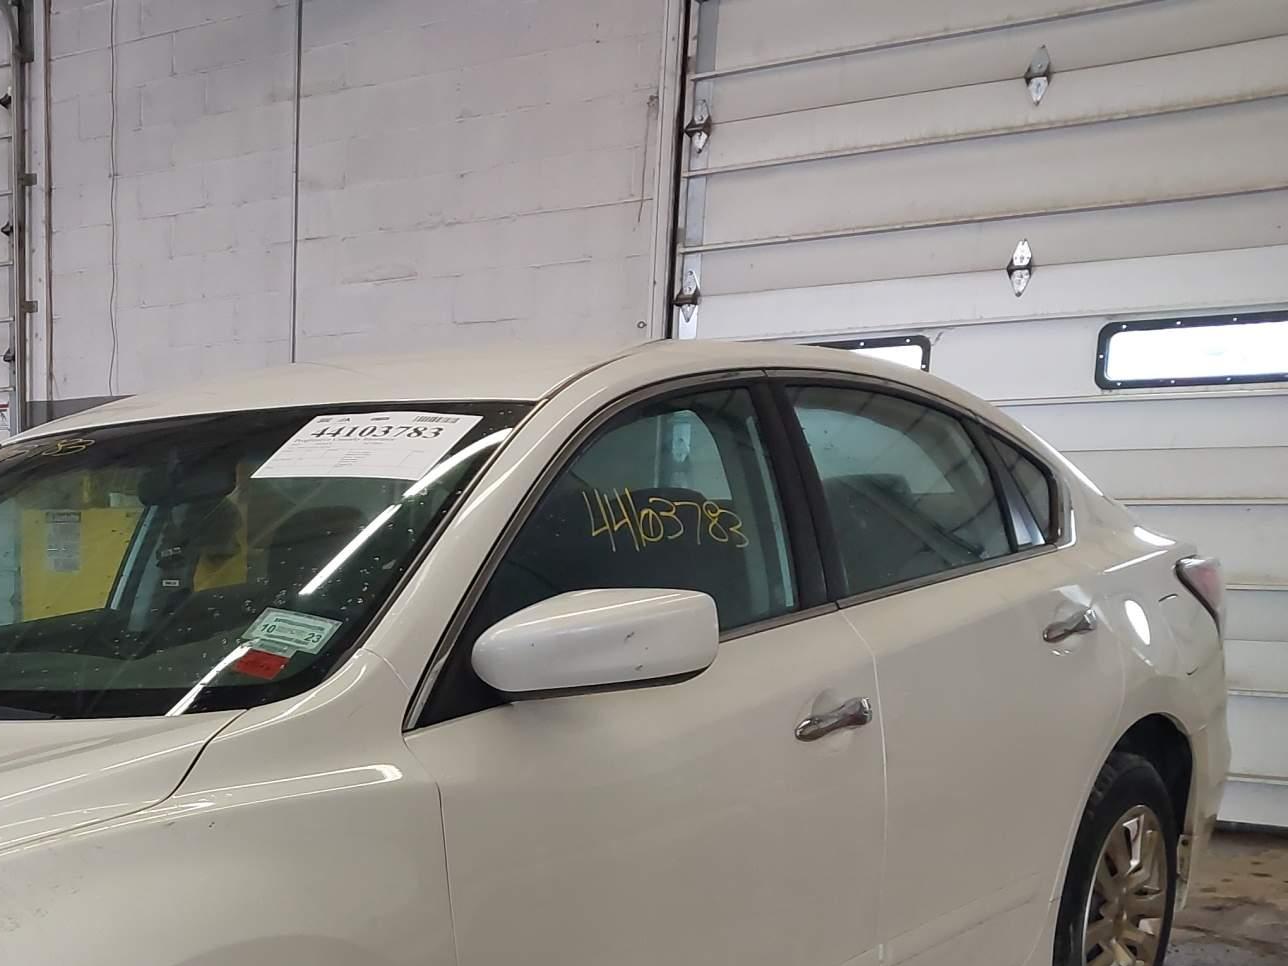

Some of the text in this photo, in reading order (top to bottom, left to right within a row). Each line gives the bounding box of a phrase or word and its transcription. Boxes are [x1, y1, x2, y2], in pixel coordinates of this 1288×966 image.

[311, 425, 444, 439] 44103783
[261, 623, 277, 634] 10
[303, 632, 322, 643] 23
